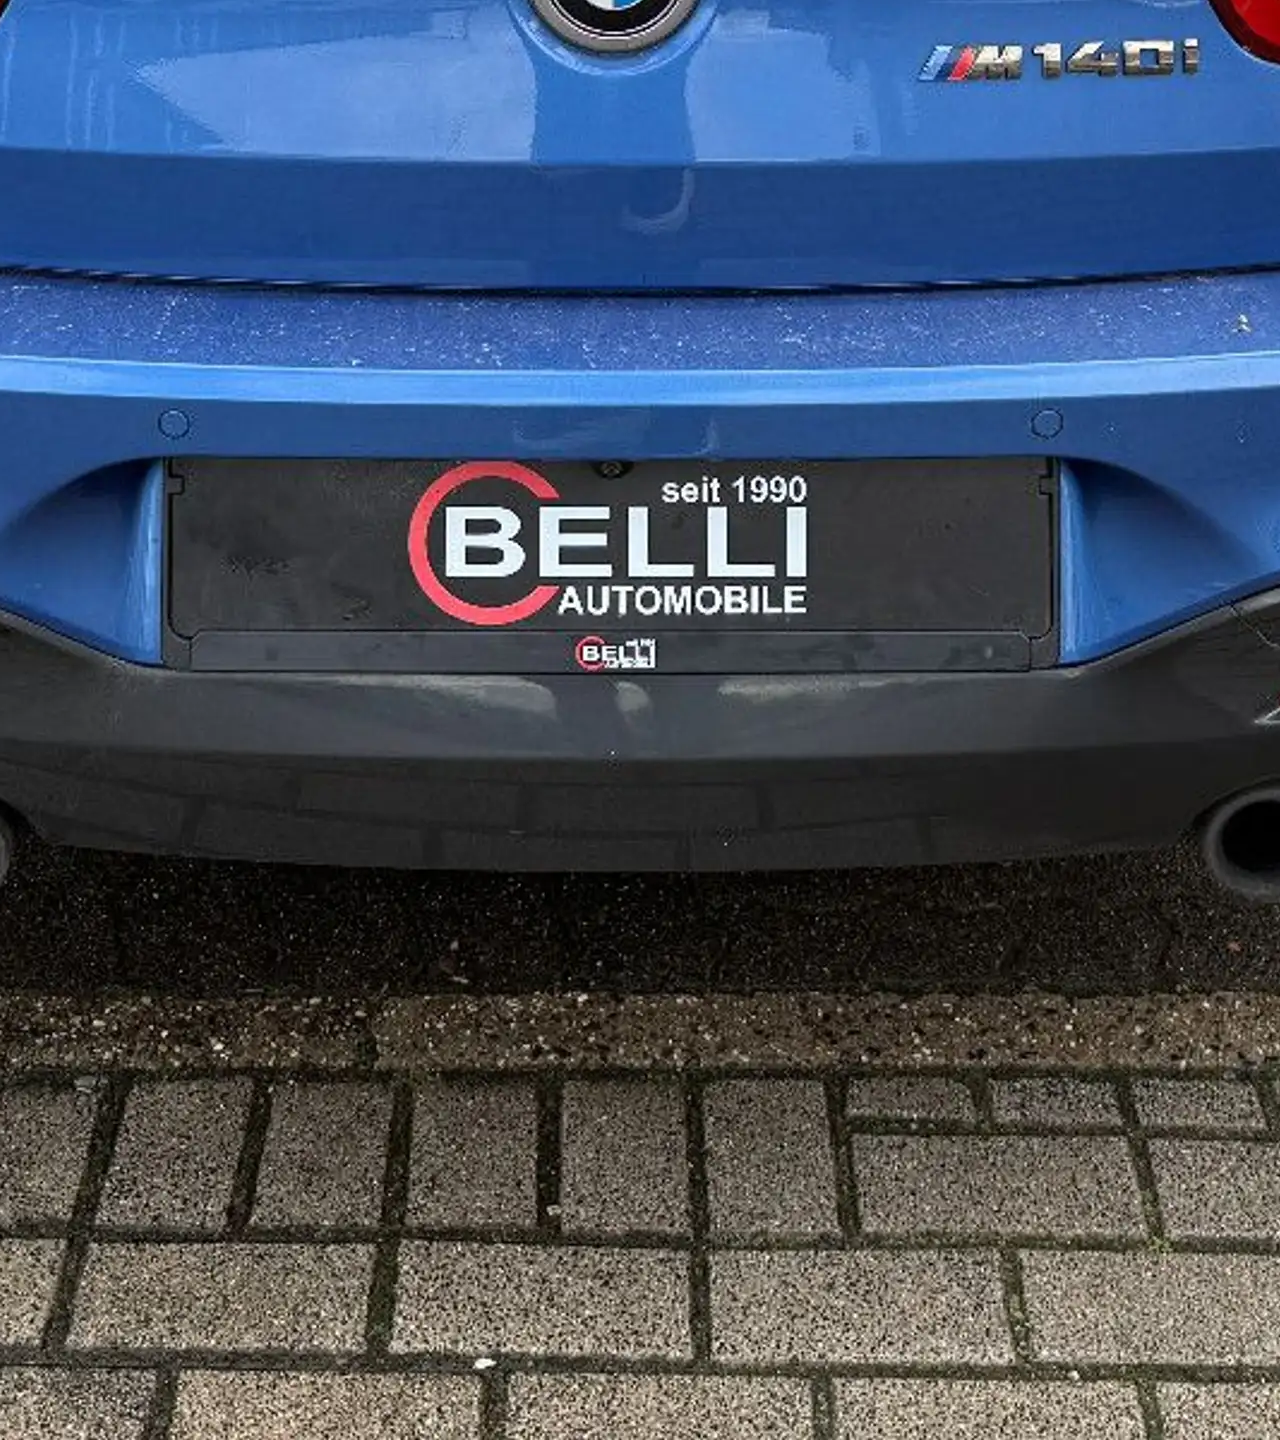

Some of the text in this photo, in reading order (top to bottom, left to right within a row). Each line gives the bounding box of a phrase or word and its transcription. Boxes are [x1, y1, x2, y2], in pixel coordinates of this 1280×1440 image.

[661, 478, 807, 505] seit 1990
[445, 506, 808, 578] BELLI
[557, 586, 806, 615] AUTOMOBILE
